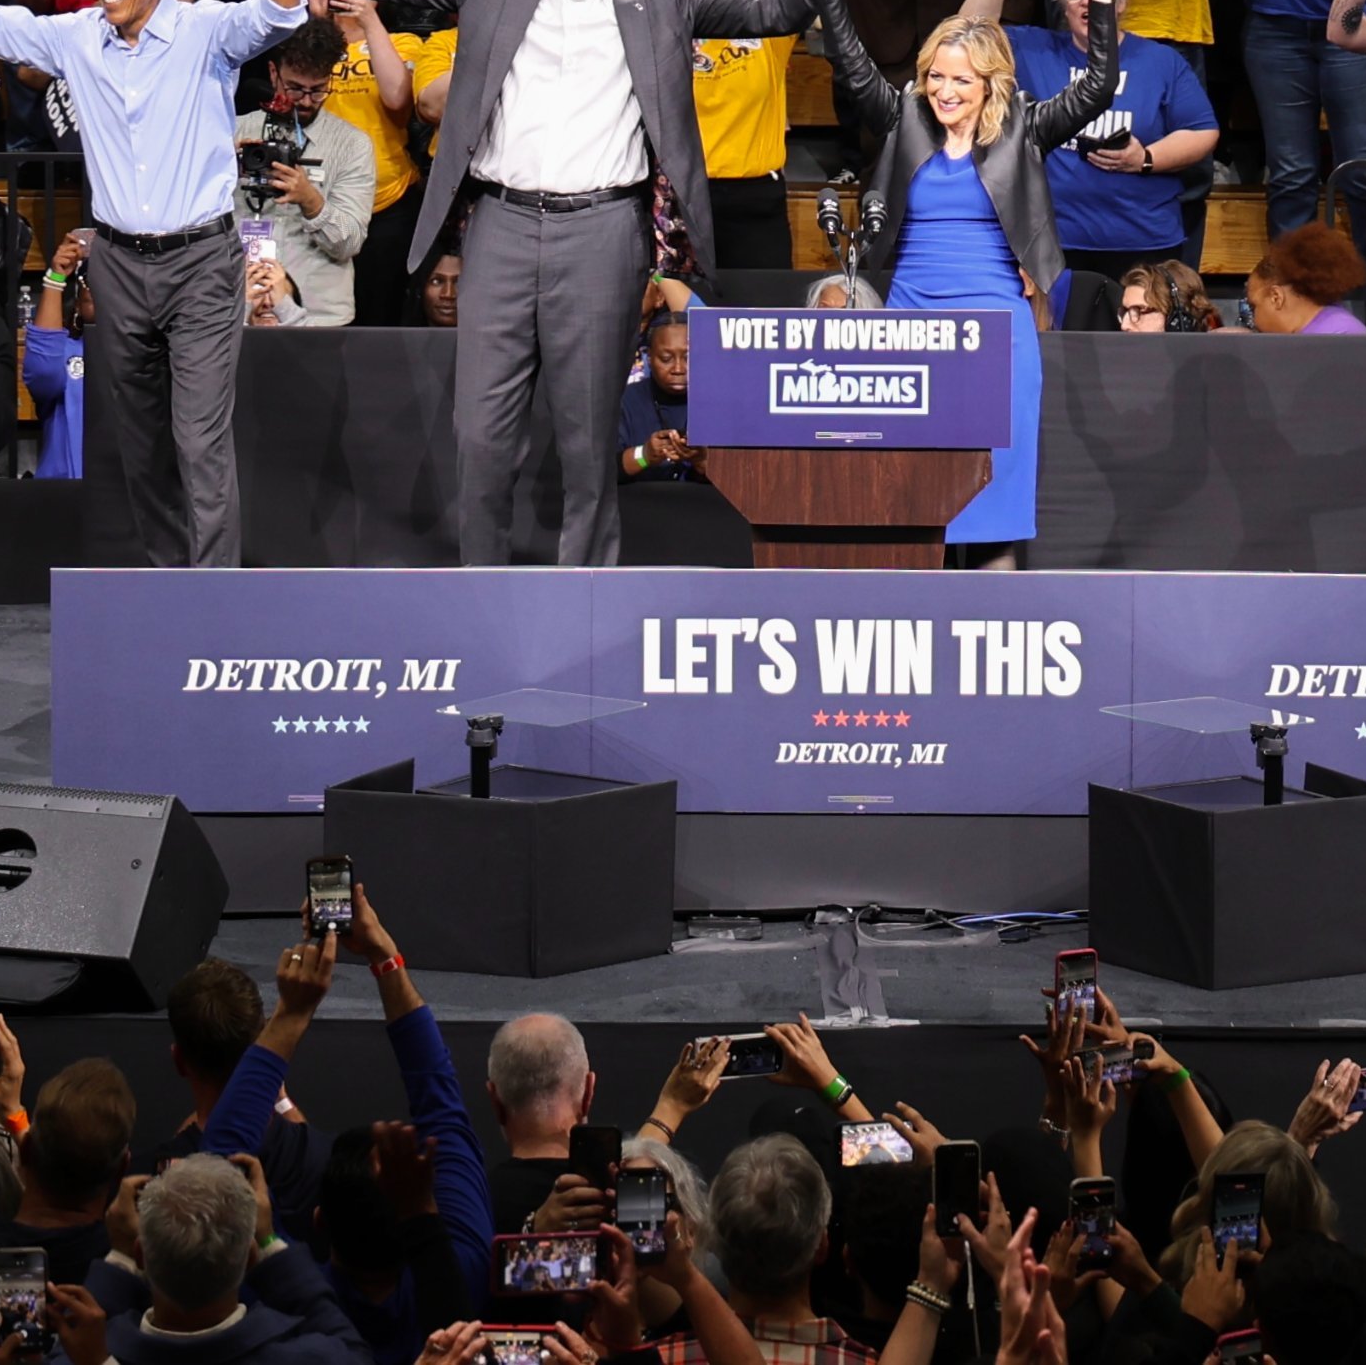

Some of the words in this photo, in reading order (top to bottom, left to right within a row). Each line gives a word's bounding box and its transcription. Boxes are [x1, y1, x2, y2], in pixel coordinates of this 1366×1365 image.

[719, 317, 781, 350] VOTE
[784, 319, 816, 350] BY
[822, 319, 957, 351] NOVEMBER
[962, 319, 980, 352] 3
[643, 618, 798, 695] LET'S
[815, 618, 933, 695] WIN
[951, 619, 1082, 697] THIS
[182, 657, 387, 699] DETROIT,
[397, 658, 462, 692] MI
[776, 741, 902, 767] DETROIT,
[908, 742, 946, 765] MI
